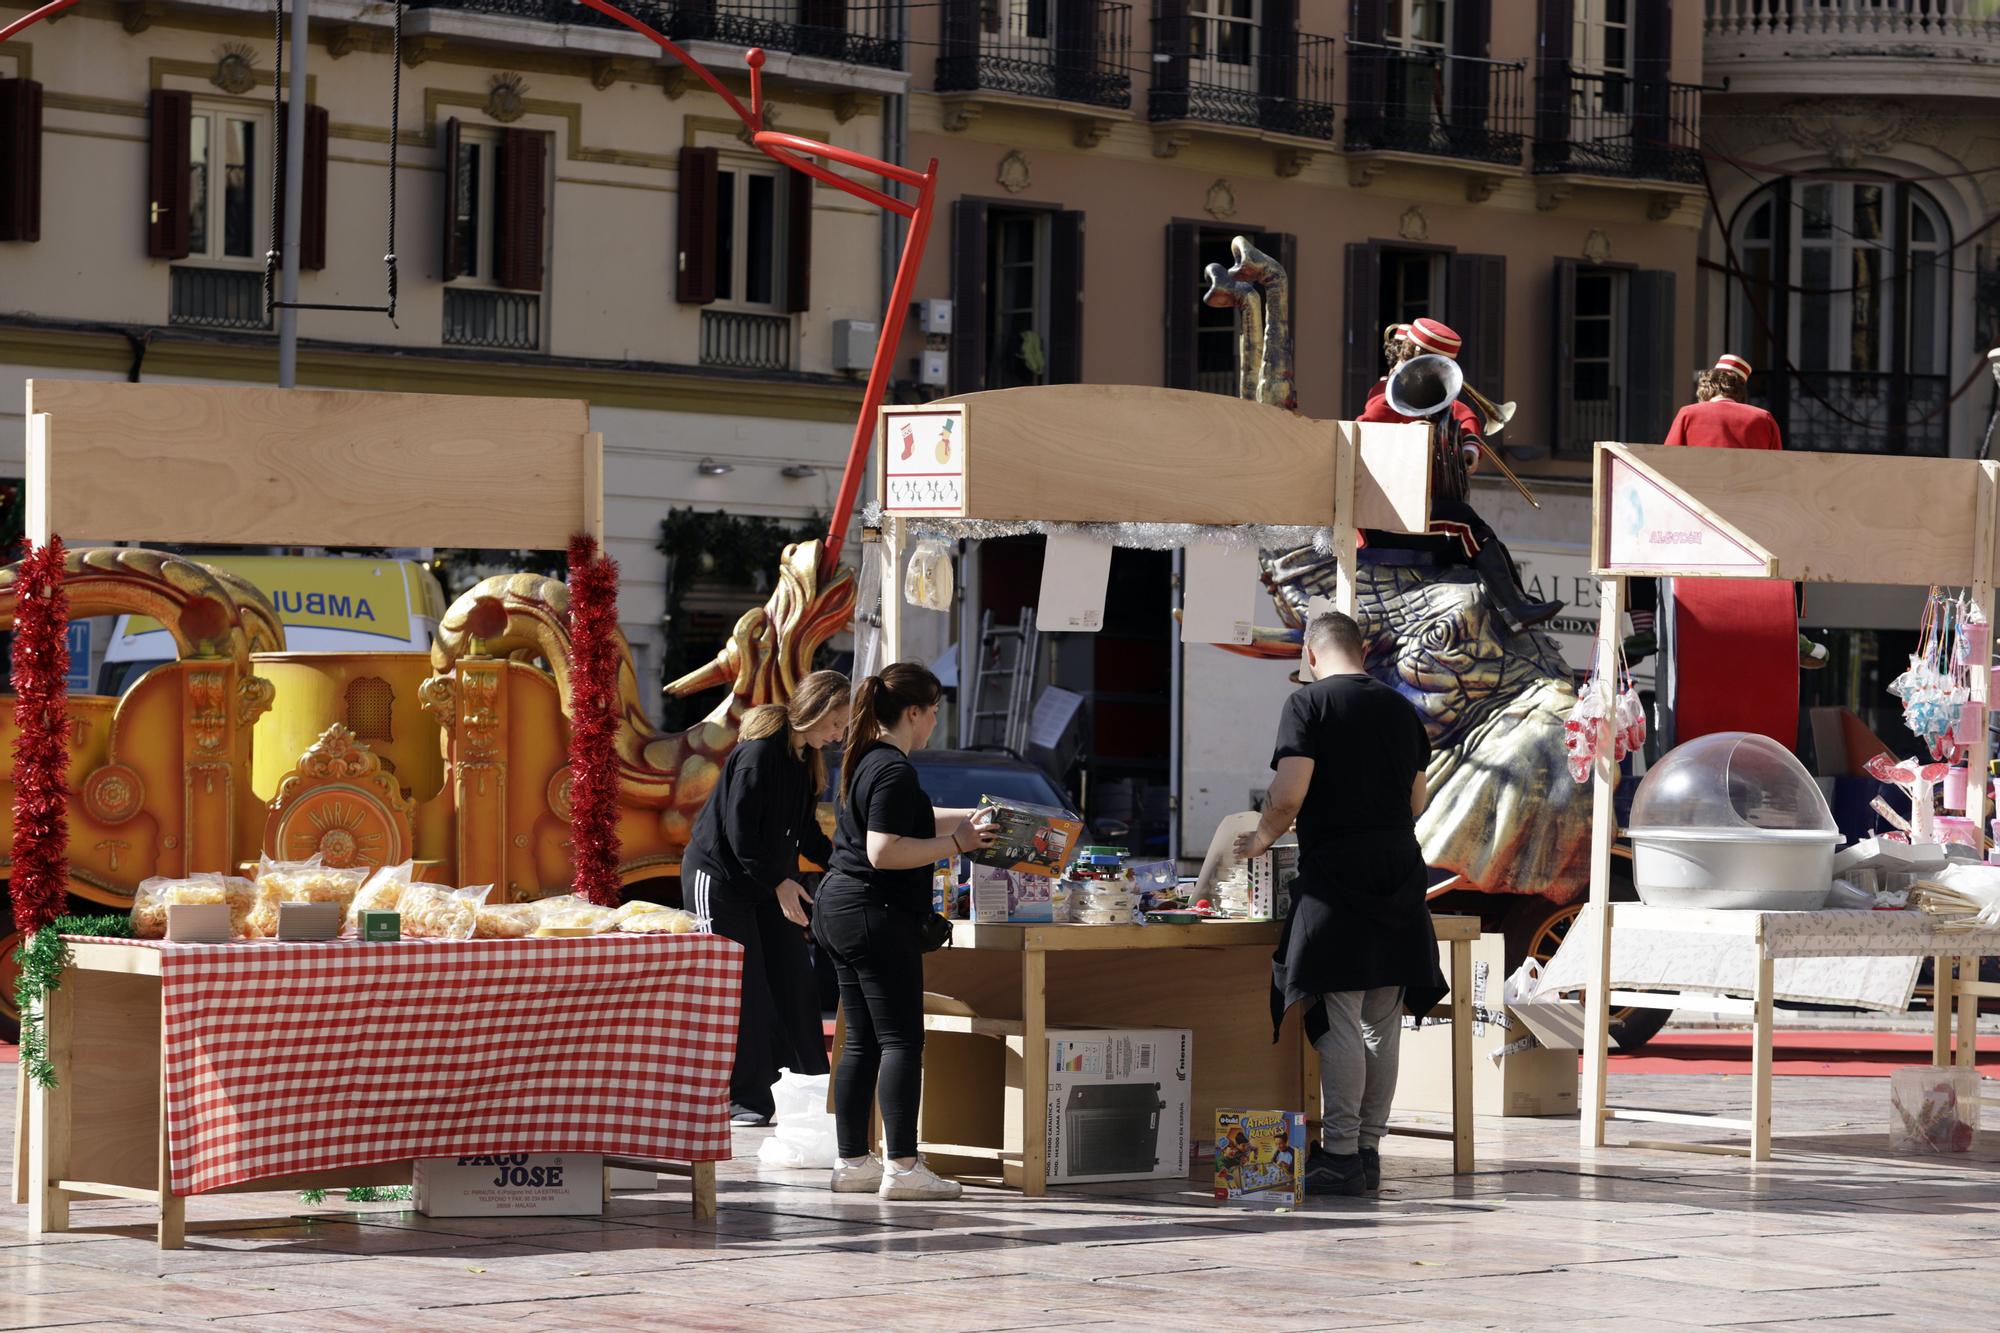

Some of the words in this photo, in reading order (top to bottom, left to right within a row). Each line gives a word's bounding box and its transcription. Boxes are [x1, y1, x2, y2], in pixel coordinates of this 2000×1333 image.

[1246, 1116, 1281, 1128] ATRAPA
[1249, 1126, 1285, 1138] RATONES
[493, 1166, 563, 1187] JOSE
